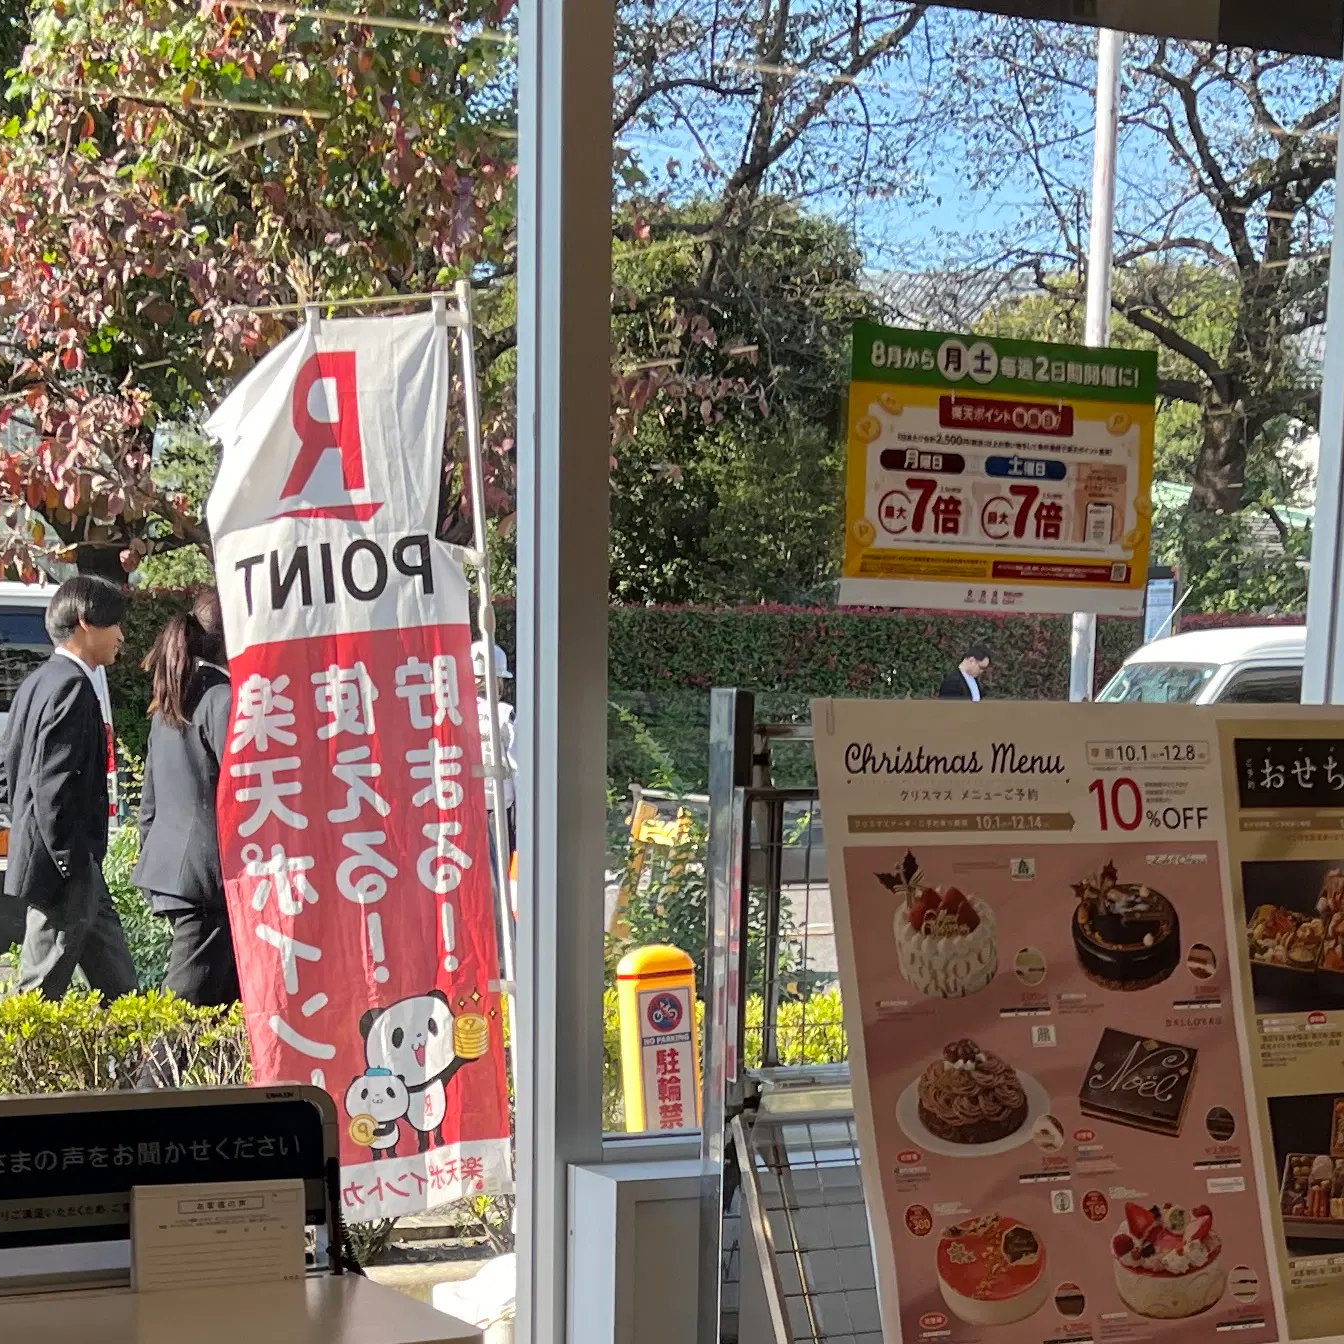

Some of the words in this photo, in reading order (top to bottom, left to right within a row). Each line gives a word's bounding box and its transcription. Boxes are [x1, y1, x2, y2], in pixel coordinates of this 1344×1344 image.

[903, 448, 943, 470] 月曜日
[1007, 454, 1047, 477] 土曜日
[906, 478, 962, 535] 7倍
[1009, 485, 1063, 541] 7倍
[845, 742, 984, 775] Christmas
[991, 742, 1066, 775] Menu
[899, 788, 953, 802] クリスマス
